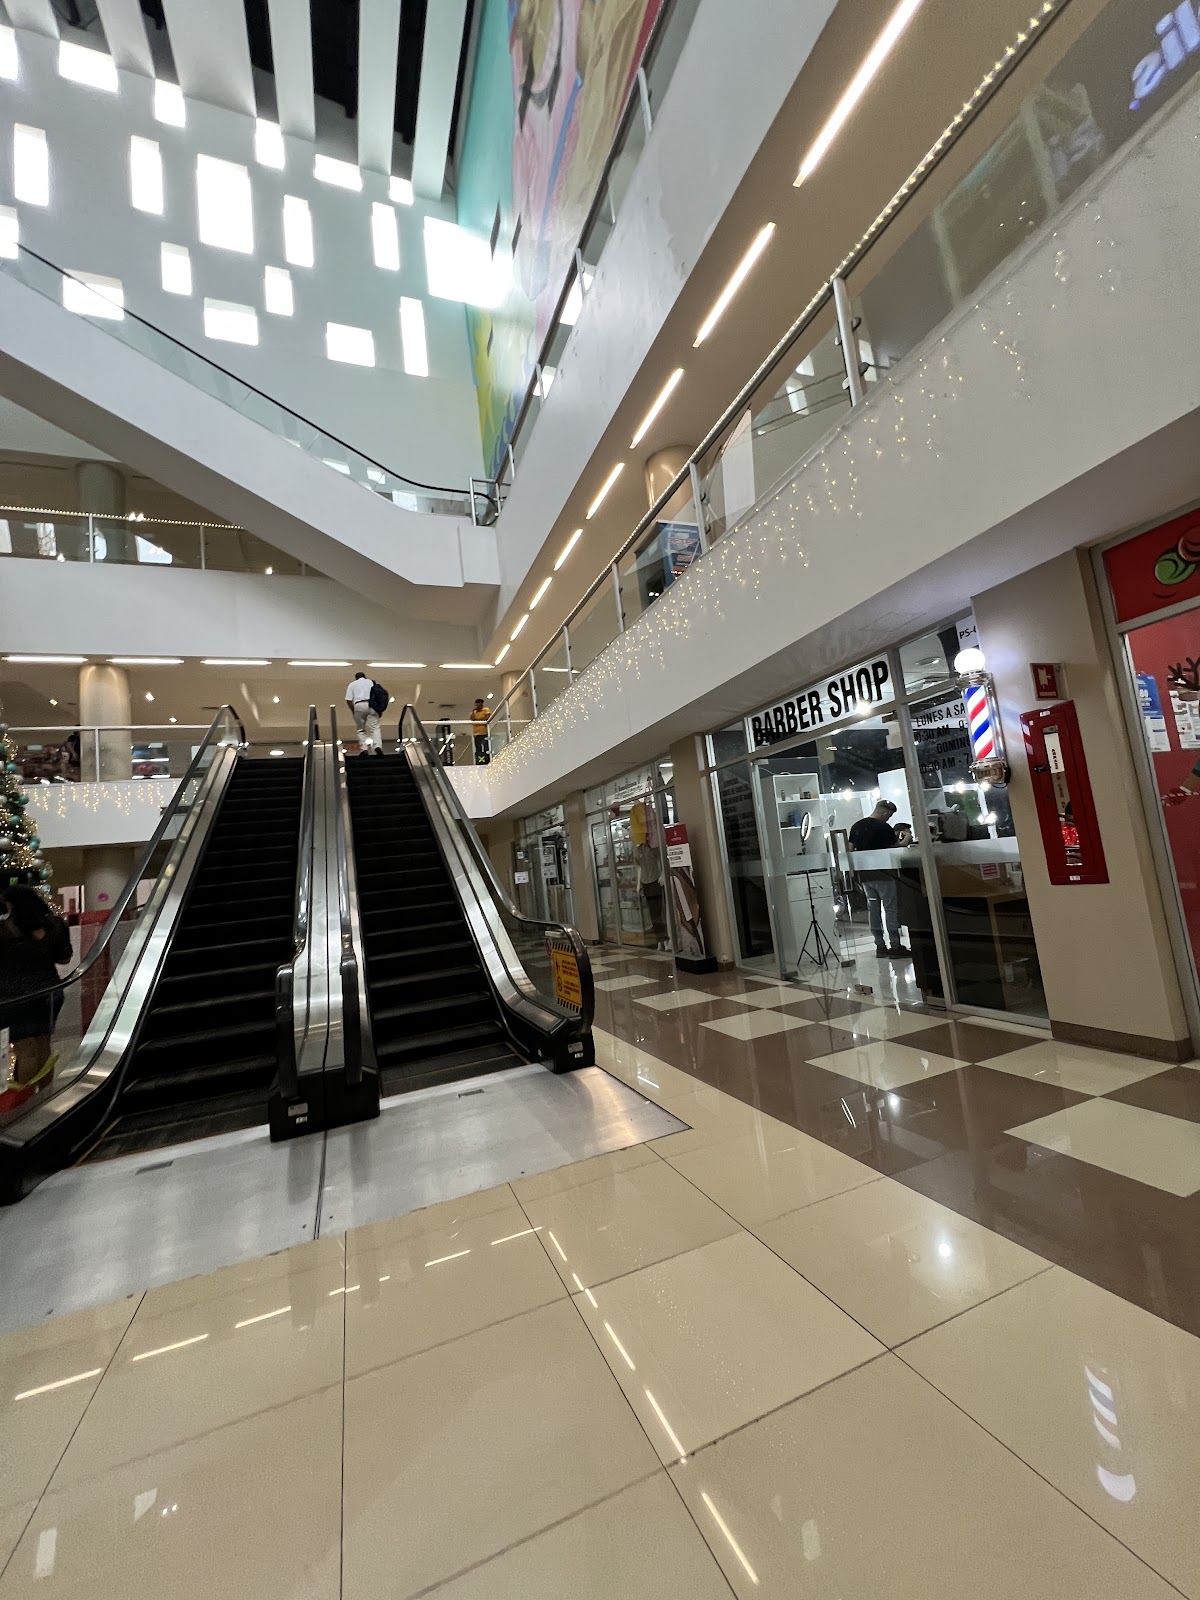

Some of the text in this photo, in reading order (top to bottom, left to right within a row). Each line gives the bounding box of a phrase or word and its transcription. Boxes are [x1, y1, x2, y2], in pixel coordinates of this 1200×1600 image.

[752, 660, 889, 747] BARBER SHOP
[915, 709, 944, 728] LUNES
[946, 702, 952, 719] A
[936, 724, 951, 739] AM
[942, 756, 956, 770] AM
